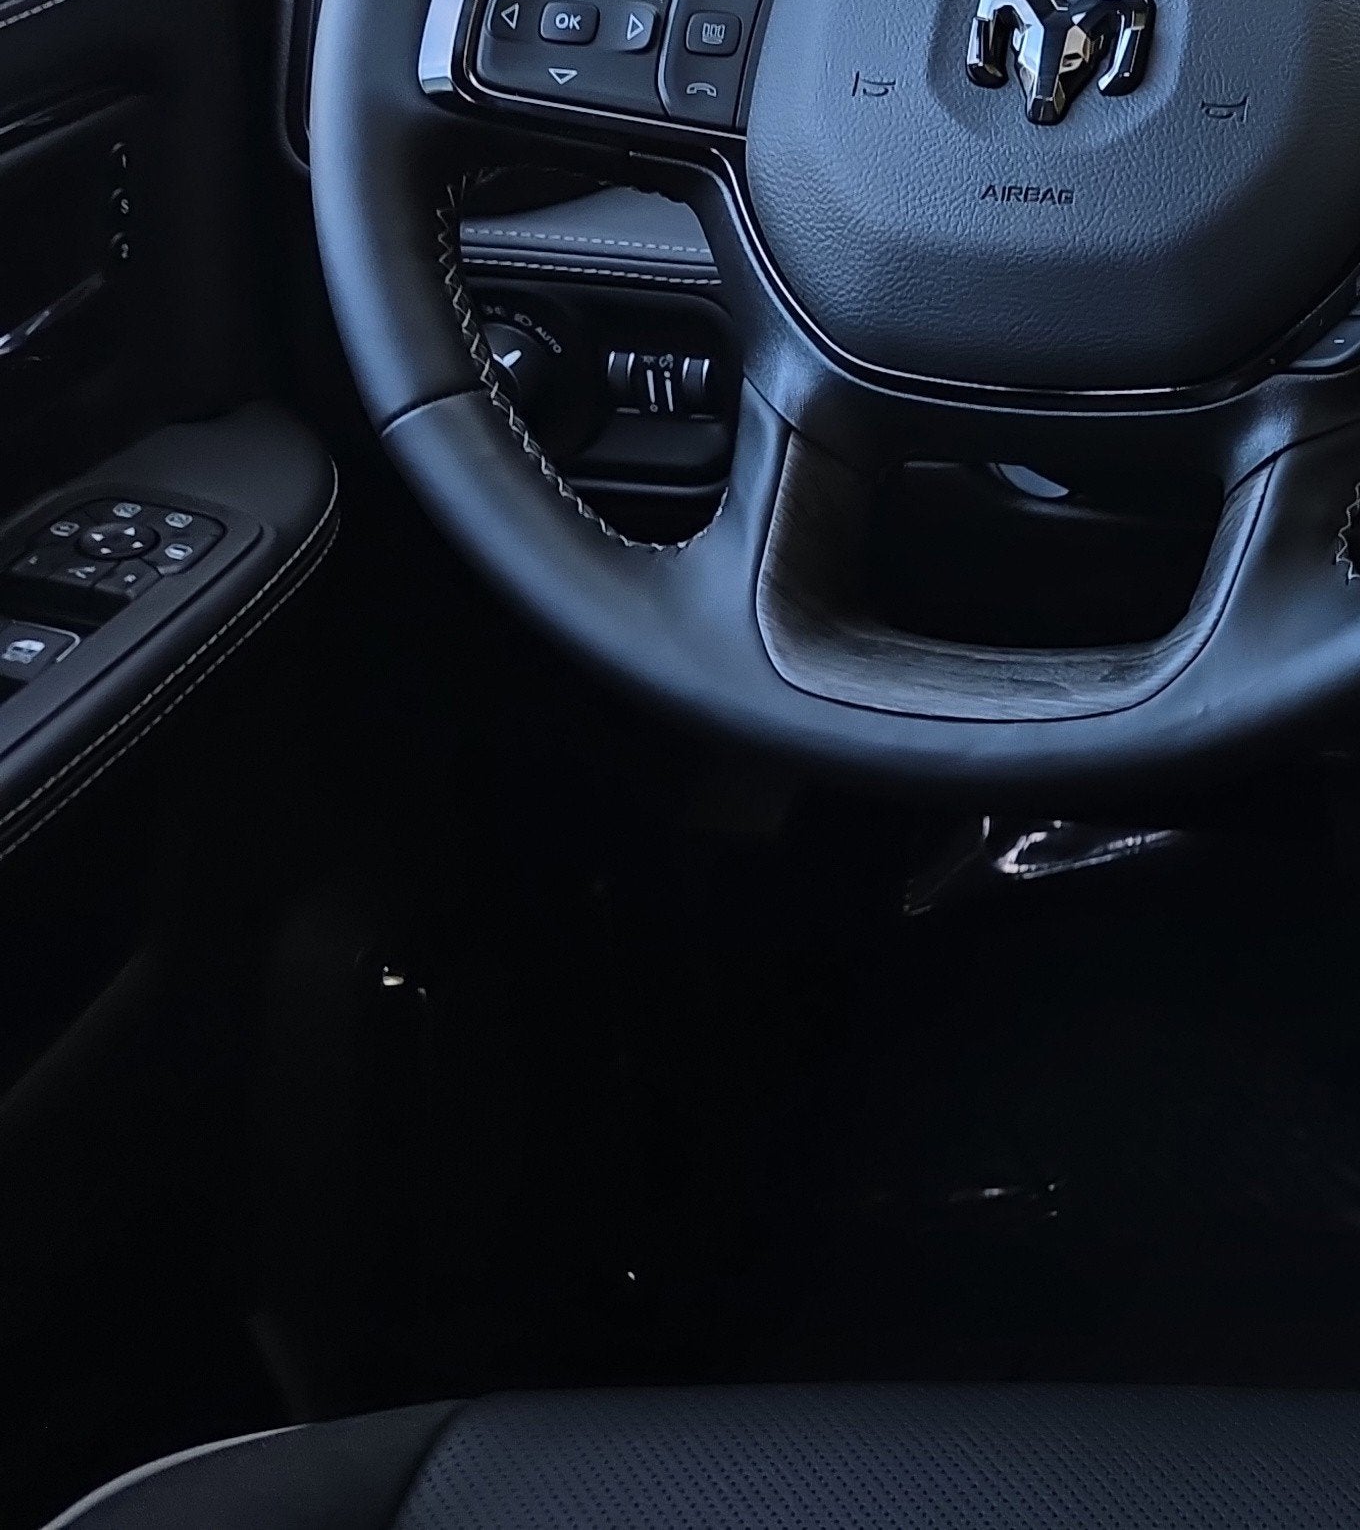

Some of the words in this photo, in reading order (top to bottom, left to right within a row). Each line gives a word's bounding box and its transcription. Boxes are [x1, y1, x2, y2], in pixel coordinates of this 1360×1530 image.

[554, 12, 583, 32] OK
[979, 182, 1076, 207] AIRBAG
[533, 325, 563, 355] AUTO
